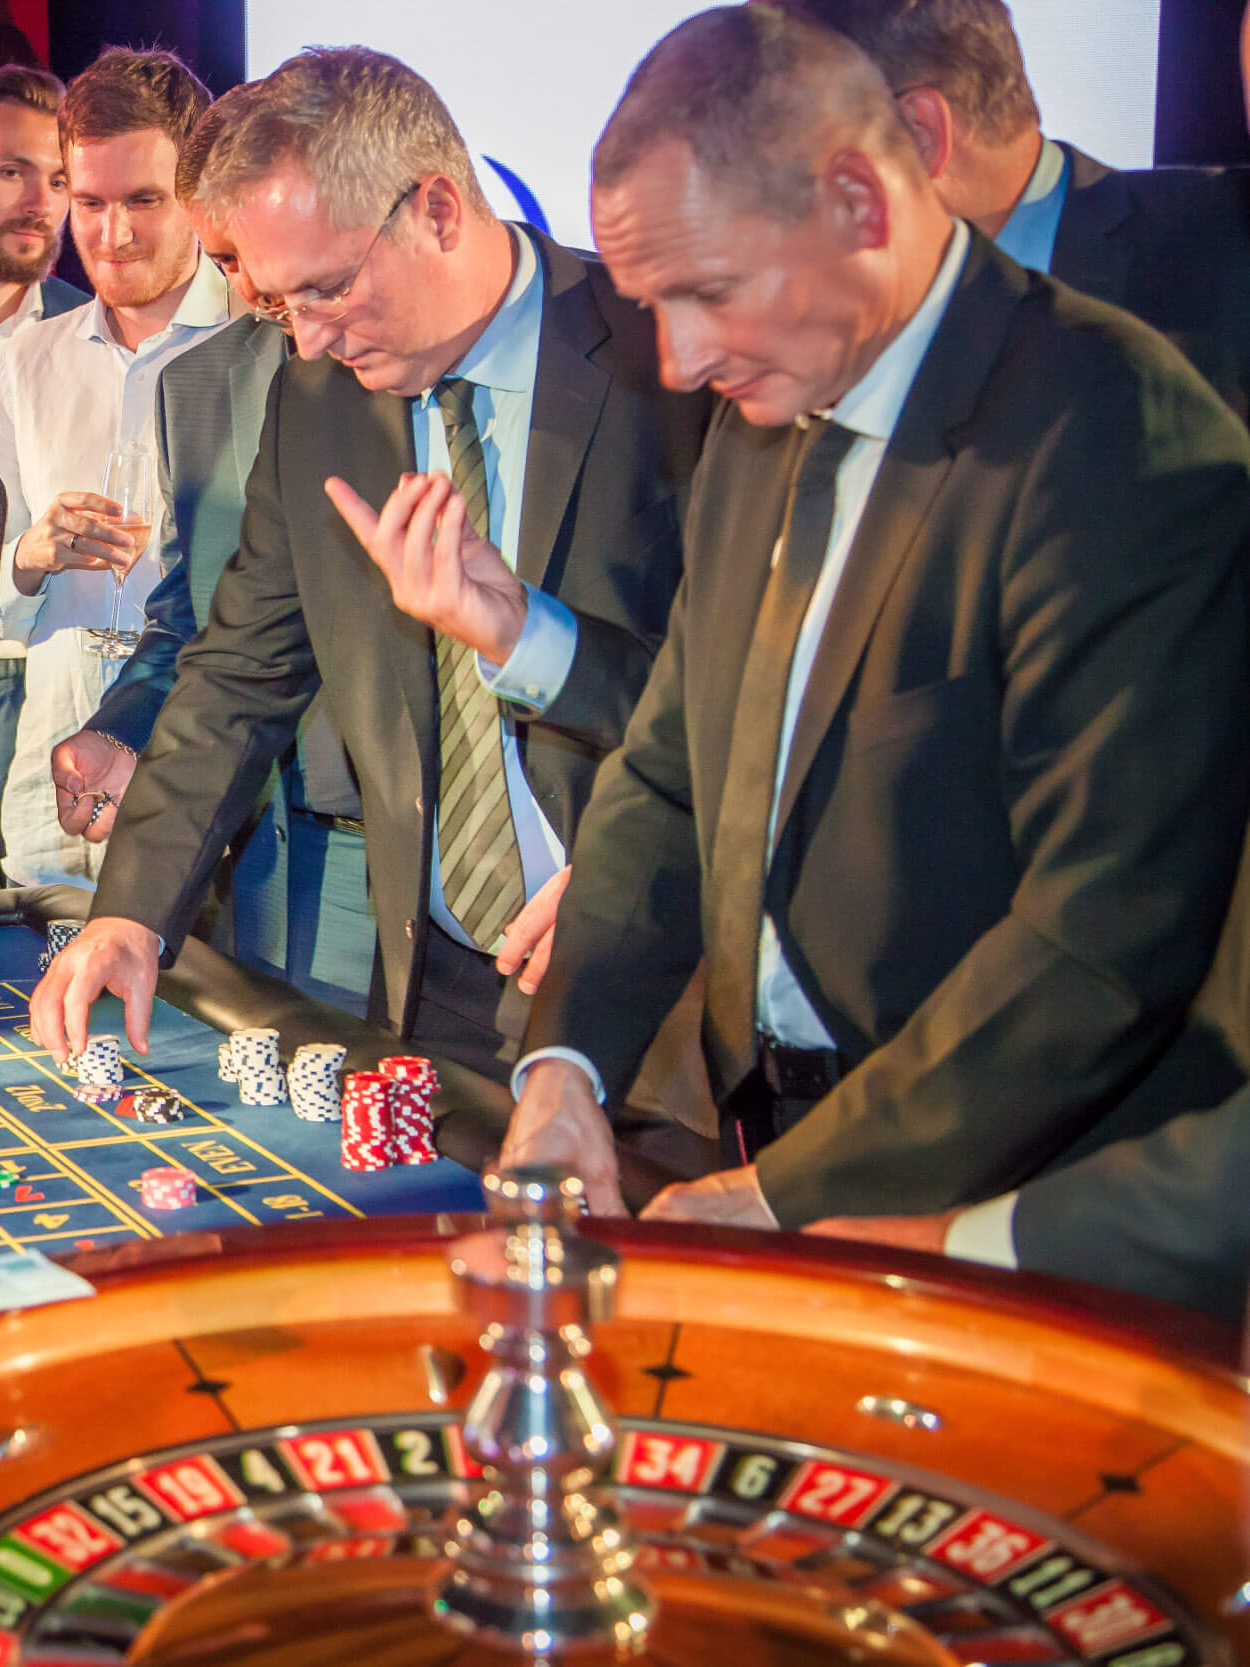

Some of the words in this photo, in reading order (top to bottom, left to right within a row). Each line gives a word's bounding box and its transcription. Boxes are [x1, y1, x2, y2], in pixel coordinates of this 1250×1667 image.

[181, 1140, 258, 1174] EVEN
[15, 1185, 46, 1203] 7
[33, 1213, 70, 1229] 4
[245, 1449, 285, 1493] 4
[302, 1438, 370, 1483] 21
[395, 1430, 438, 1475] 2
[636, 1438, 702, 1485] 34
[733, 1454, 777, 1497] 6
[90, 1485, 162, 1536] 15
[156, 1465, 225, 1513] 19
[799, 1471, 876, 1518] 27
[32, 1513, 106, 1561] 32
[877, 1495, 954, 1543] 13
[948, 1520, 1029, 1572] 36
[1010, 1556, 1095, 1608] 11
